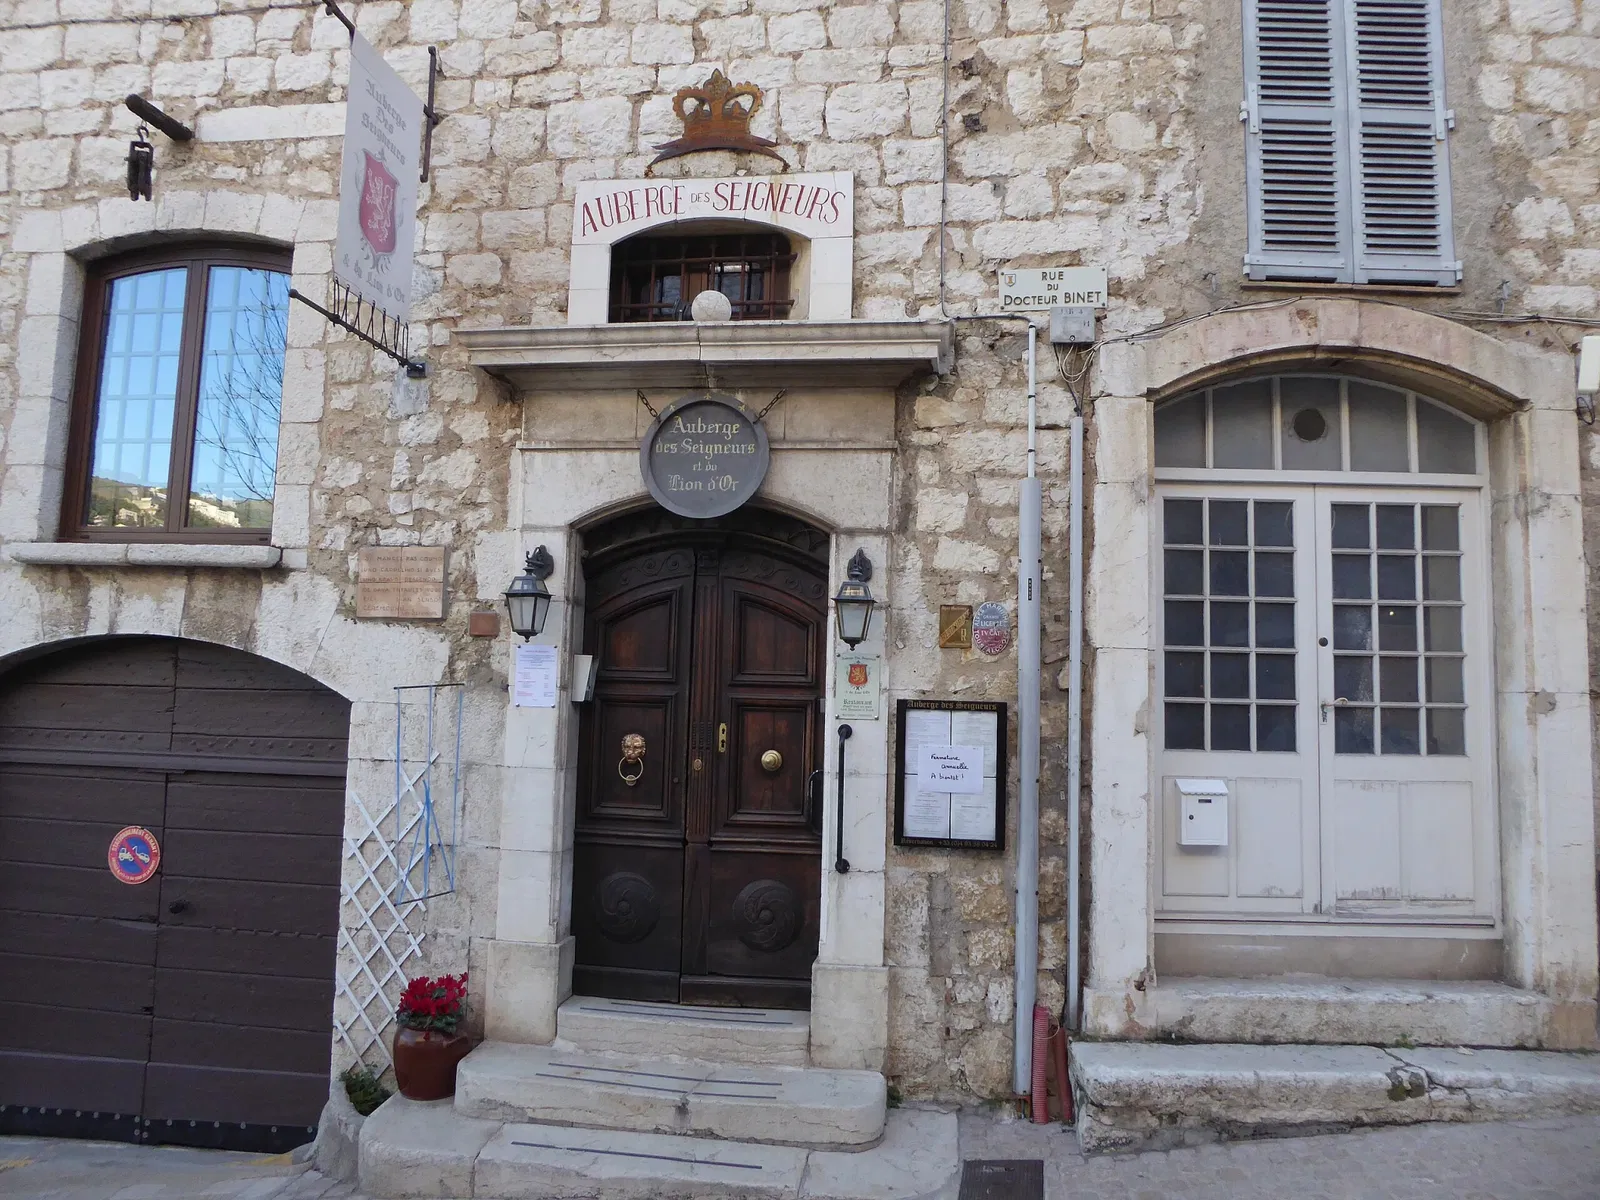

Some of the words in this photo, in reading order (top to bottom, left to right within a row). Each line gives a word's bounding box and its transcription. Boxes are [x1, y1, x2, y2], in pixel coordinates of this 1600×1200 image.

[366, 79, 407, 131] Auberge
[361, 112, 405, 166] Seigneurs
[582, 184, 687, 237] AUBERGE
[691, 192, 711, 204] DES
[712, 181, 847, 225] SEIGNEURS
[1041, 271, 1064, 281] RUE
[1047, 283, 1059, 291] DU
[1004, 294, 1058, 306] DOCTEUR
[1064, 291, 1102, 304] BINET
[670, 415, 740, 440] Auberge
[656, 438, 678, 454] des
[680, 438, 756, 460] Seigneurs
[692, 461, 702, 471] et
[705, 461, 718, 471] du
[667, 474, 703, 491] Lion
[707, 474, 739, 492] d'Or
[907, 700, 939, 709] Auberge
[956, 702, 997, 710] Seigneurs
